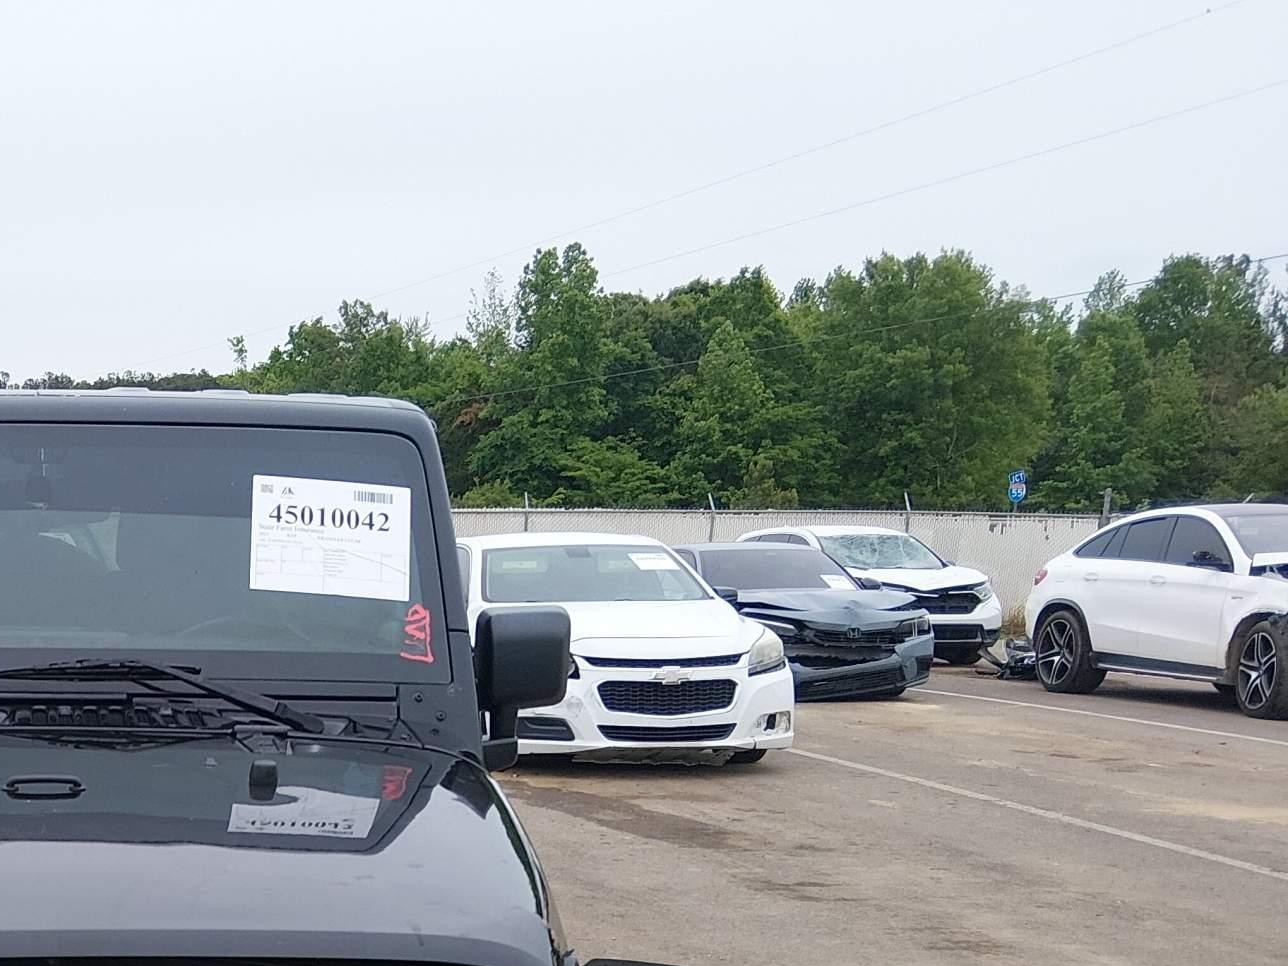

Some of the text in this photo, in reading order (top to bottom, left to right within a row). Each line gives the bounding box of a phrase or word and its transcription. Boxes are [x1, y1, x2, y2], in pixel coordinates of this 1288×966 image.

[1011, 472, 1024, 483] JCT
[1011, 488, 1023, 497] 55
[269, 503, 390, 532] 45010042
